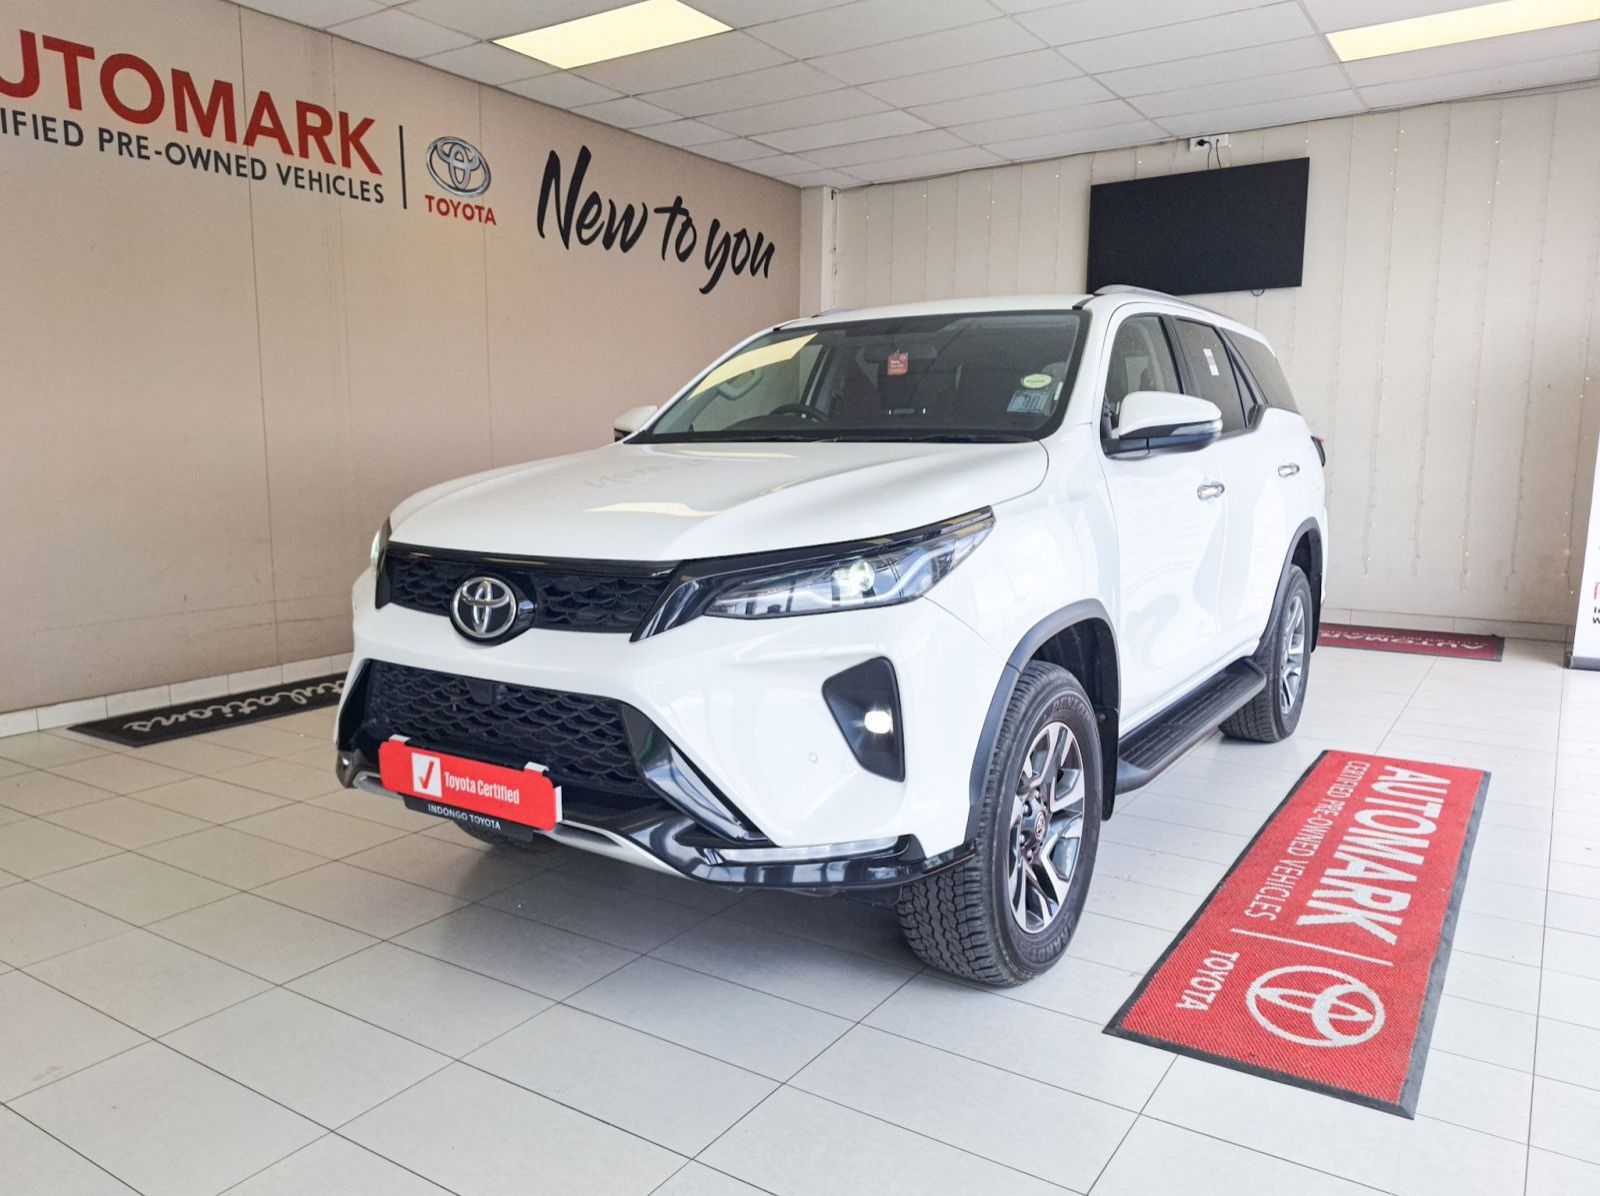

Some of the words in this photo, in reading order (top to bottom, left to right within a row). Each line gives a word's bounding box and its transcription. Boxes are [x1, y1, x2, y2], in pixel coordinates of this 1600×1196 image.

[0, 107, 84, 147] IFIED
[98, 127, 267, 181] PRE-OWNED
[276, 163, 385, 204] VEHICLES
[424, 194, 497, 226] TOYOTA
[536, 145, 648, 254] New
[654, 195, 698, 263] to
[699, 218, 775, 295] you
[444, 772, 477, 793] Toyota
[477, 779, 520, 805] Certified
[1326, 760, 1371, 799] CERTIFIED
[427, 803, 468, 821] INDONGO
[469, 813, 502, 830] TOYOTA
[1286, 799, 1346, 858] PRE-OWNED
[1296, 765, 1452, 947] AUTOMARK
[1244, 857, 1306, 921] VEHICLES
[1175, 948, 1241, 1012] TOYOTA
